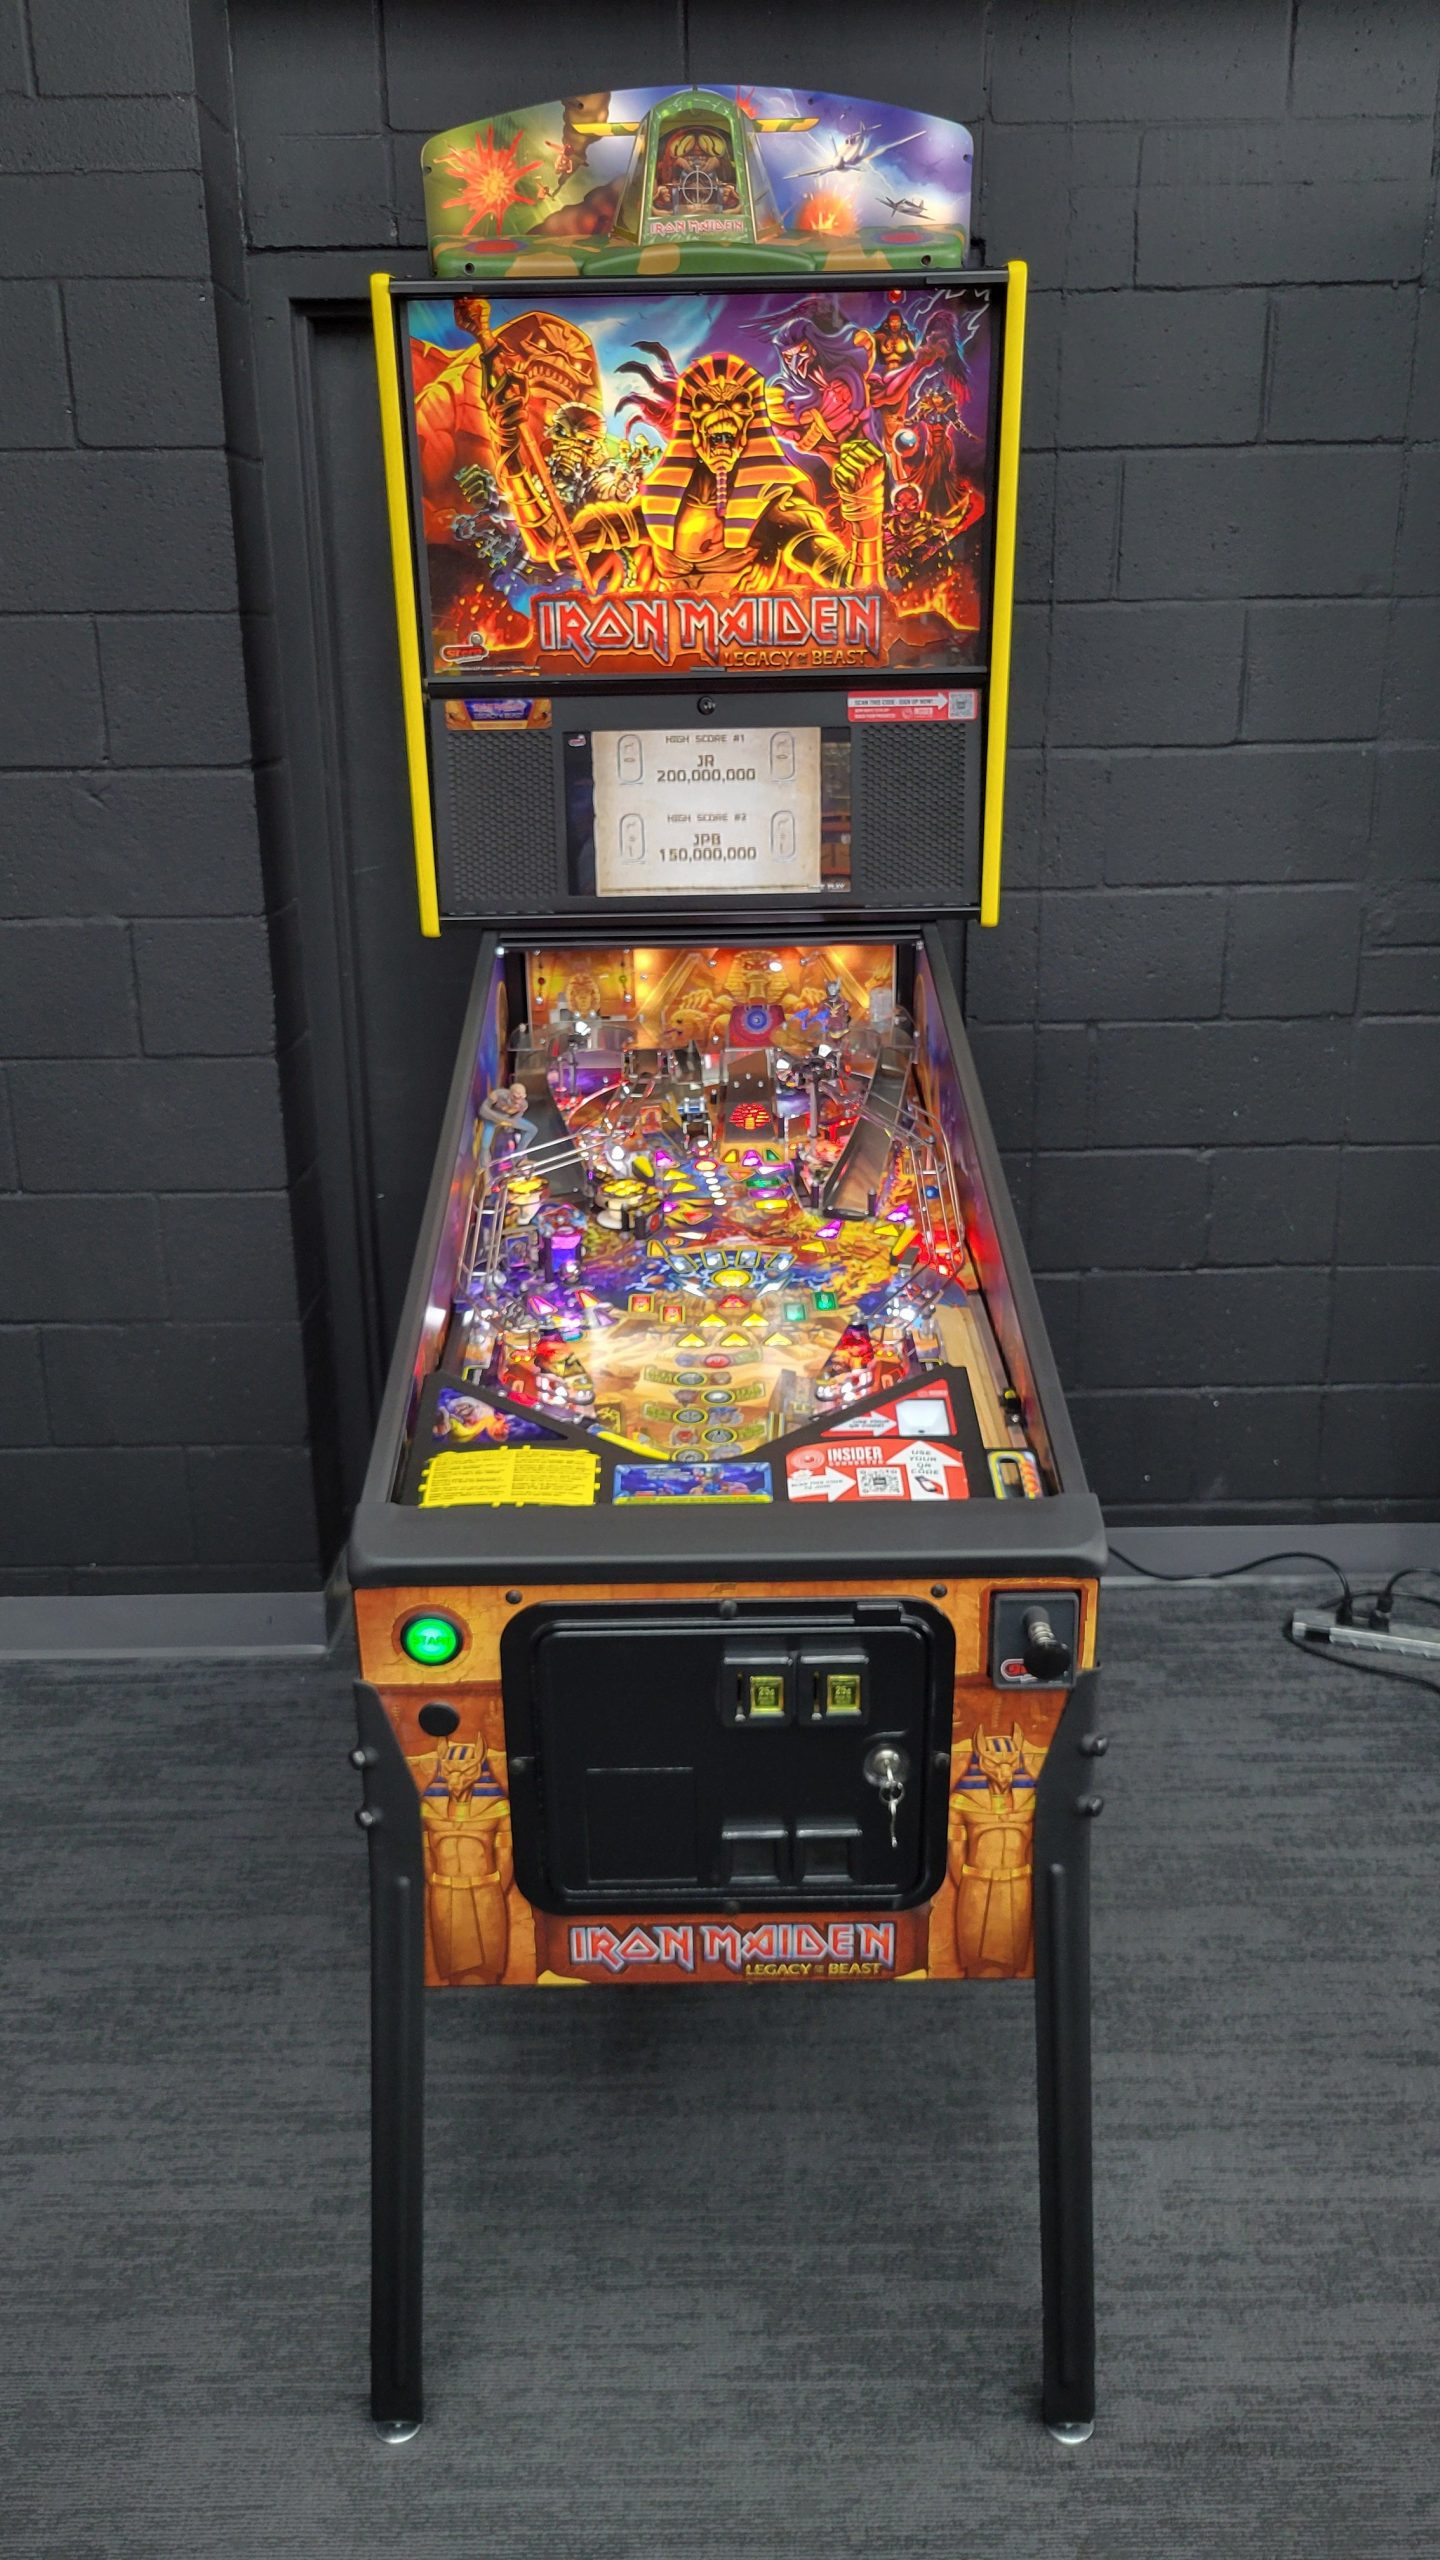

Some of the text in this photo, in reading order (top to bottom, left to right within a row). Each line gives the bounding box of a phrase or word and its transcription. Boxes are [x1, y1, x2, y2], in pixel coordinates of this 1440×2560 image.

[649, 218, 744, 236] IRON MAIDEN
[537, 596, 882, 666] IRON MAIDEN
[724, 650, 793, 667] LEGACY
[812, 649, 869, 666] BEAST
[665, 734, 745, 744] HIGH SCORE #1
[697, 754, 715, 767] JR
[656, 768, 756, 783] 200,000,000
[667, 812, 747, 823] HIGH SCORE #2
[659, 846, 757, 863] 150,000,000
[827, 1445, 883, 1462] INSIDER
[569, 1922, 897, 1974] IRON MAIDEN
[745, 1964, 810, 1977] LEGACY
[828, 1962, 881, 1976] BEAST
